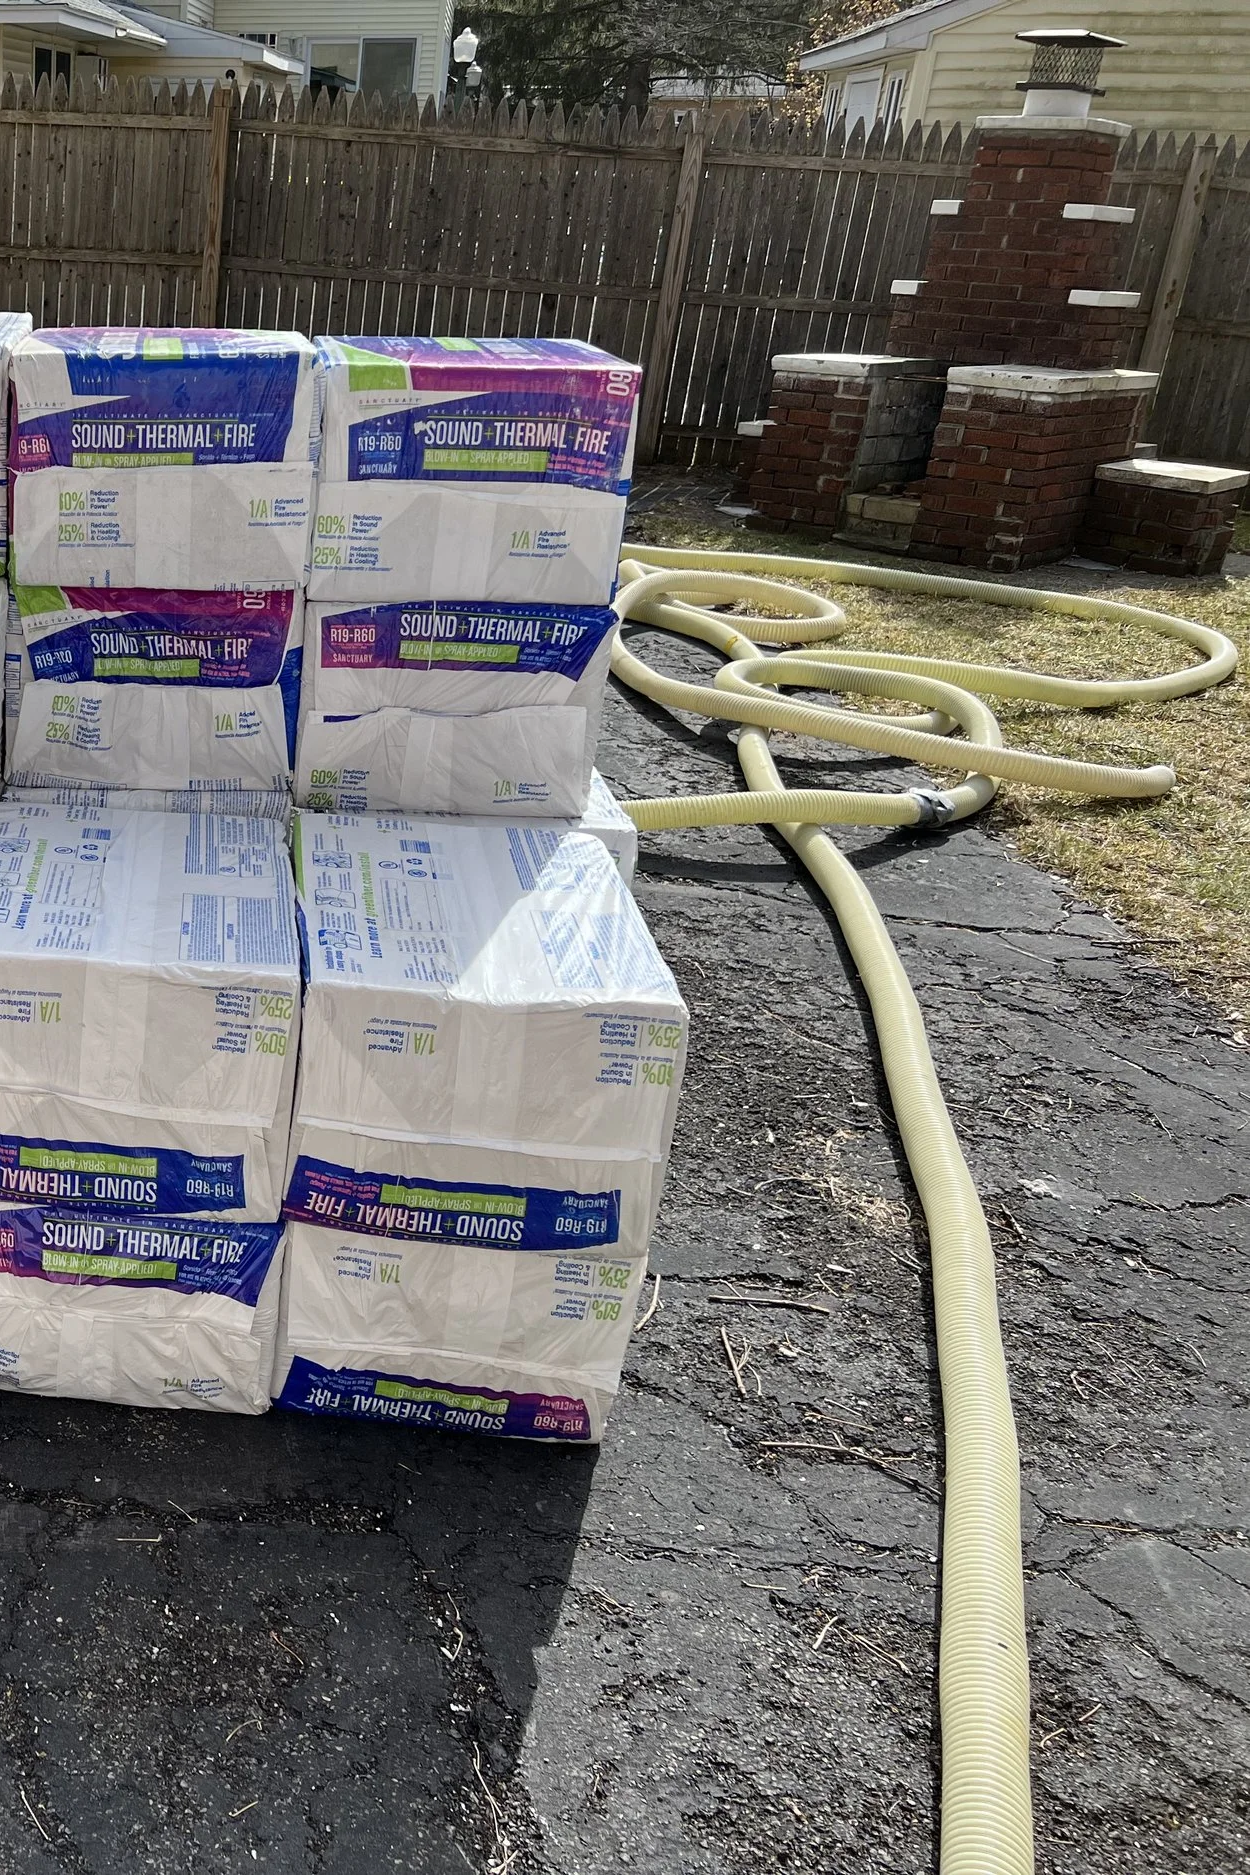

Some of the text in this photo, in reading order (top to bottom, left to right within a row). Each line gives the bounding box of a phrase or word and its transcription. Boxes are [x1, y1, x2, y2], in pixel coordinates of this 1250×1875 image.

[358, 435, 403, 452] R19-R60
[317, 515, 346, 534] 60%
[313, 546, 342, 565] 25%
[330, 628, 376, 643] R19-R60
[310, 769, 338, 784] 60%
[260, 995, 293, 1020] 25%
[255, 1031, 287, 1056] 60%
[648, 1024, 682, 1050] 25%
[118, 1163, 157, 1178] BLOW-IN
[186, 1179, 234, 1198] R19-R60
[484, 1201, 525, 1218] BLOW-IN
[554, 1216, 607, 1235] R19-R60
